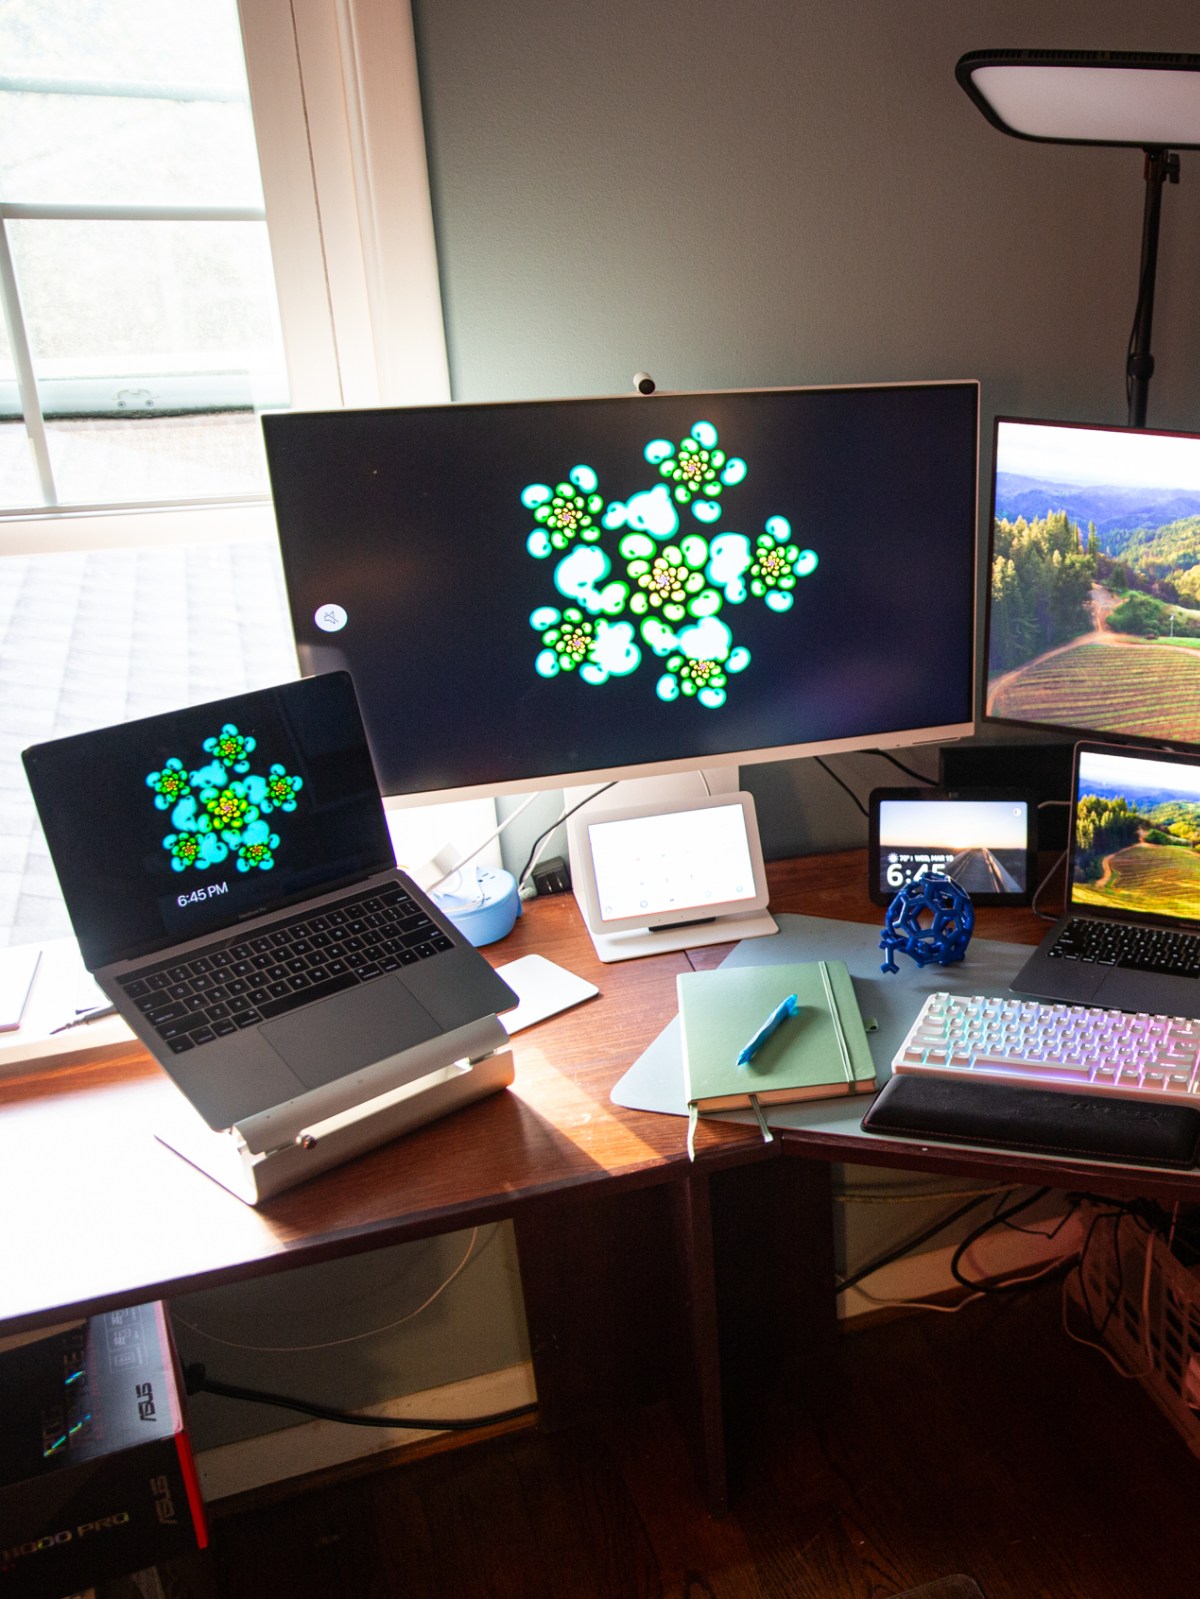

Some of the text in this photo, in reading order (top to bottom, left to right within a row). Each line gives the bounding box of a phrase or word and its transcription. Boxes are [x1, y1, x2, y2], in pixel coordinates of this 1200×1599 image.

[178, 882, 228, 907] 6:45 PM
[136, 1382, 157, 1422] ASUS
[150, 1475, 178, 1524] ASUS
[78, 1512, 130, 1536] PRO
